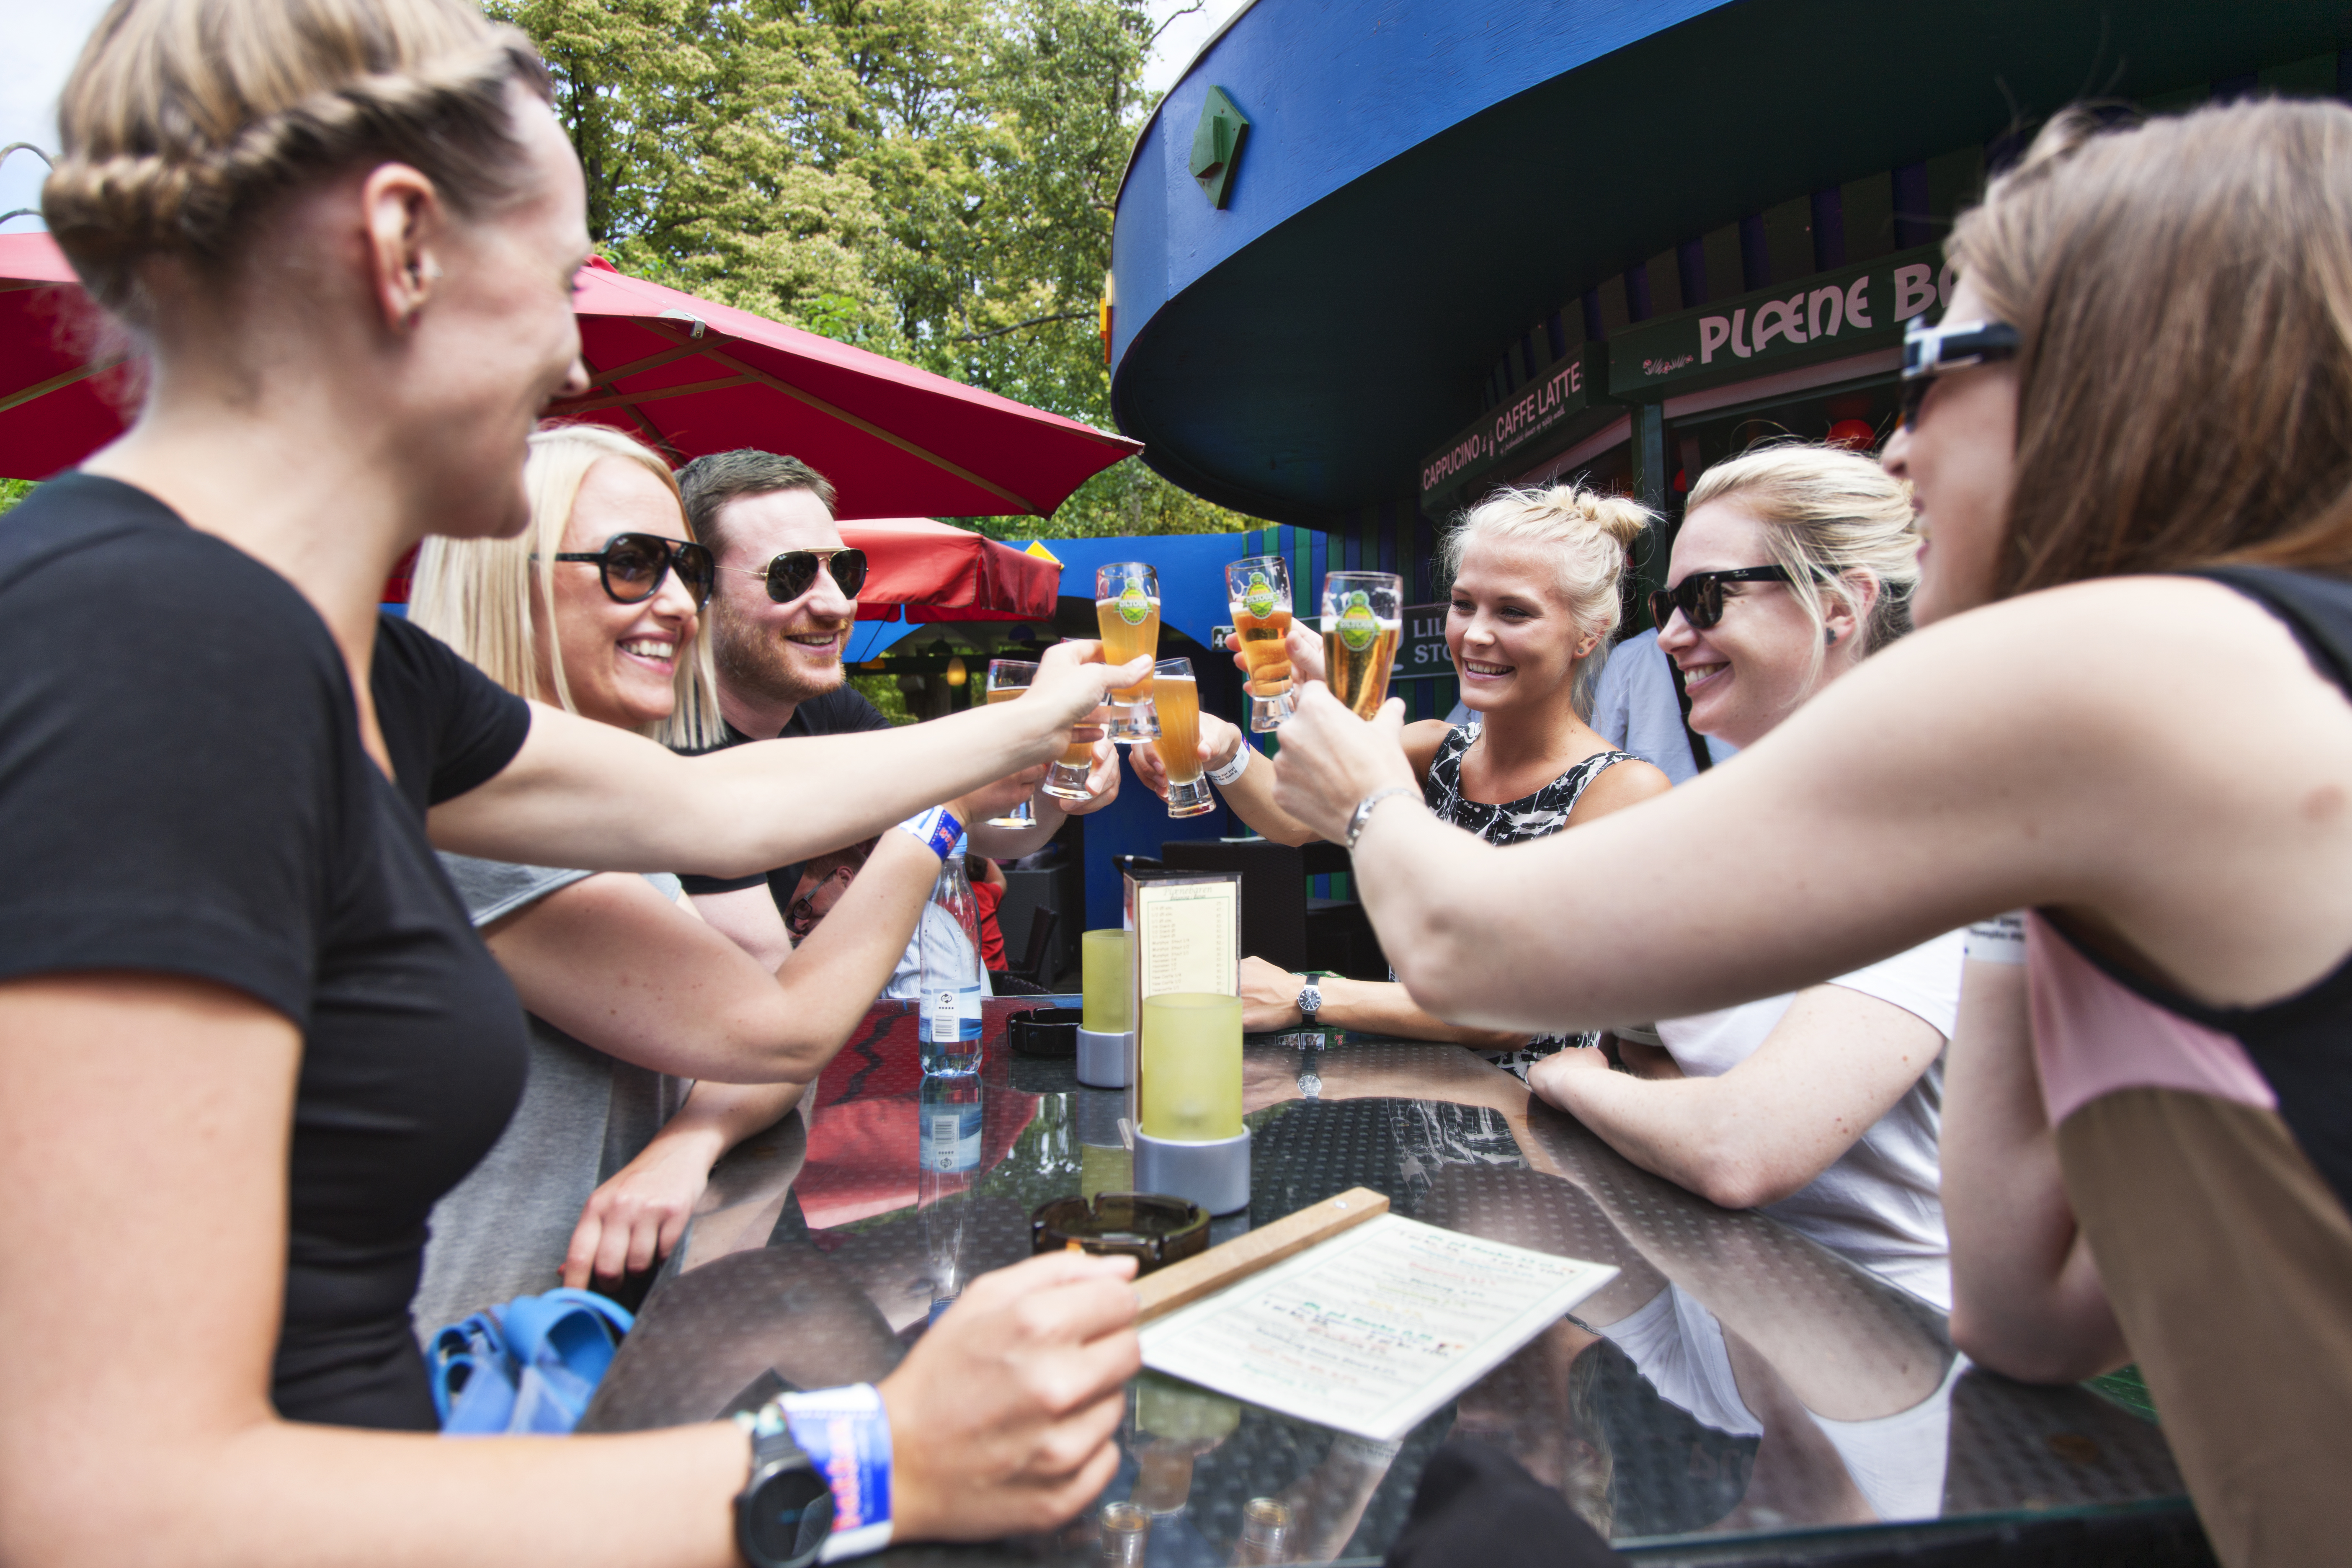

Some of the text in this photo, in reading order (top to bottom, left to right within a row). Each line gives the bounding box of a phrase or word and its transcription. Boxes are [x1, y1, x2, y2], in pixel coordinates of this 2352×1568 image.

[1424, 434, 1480, 491] CAPPUCINO
[1496, 394, 1536, 442] CAFFE
[1537, 361, 1581, 415] LATTE
[1215, 634, 1225, 647] 4
